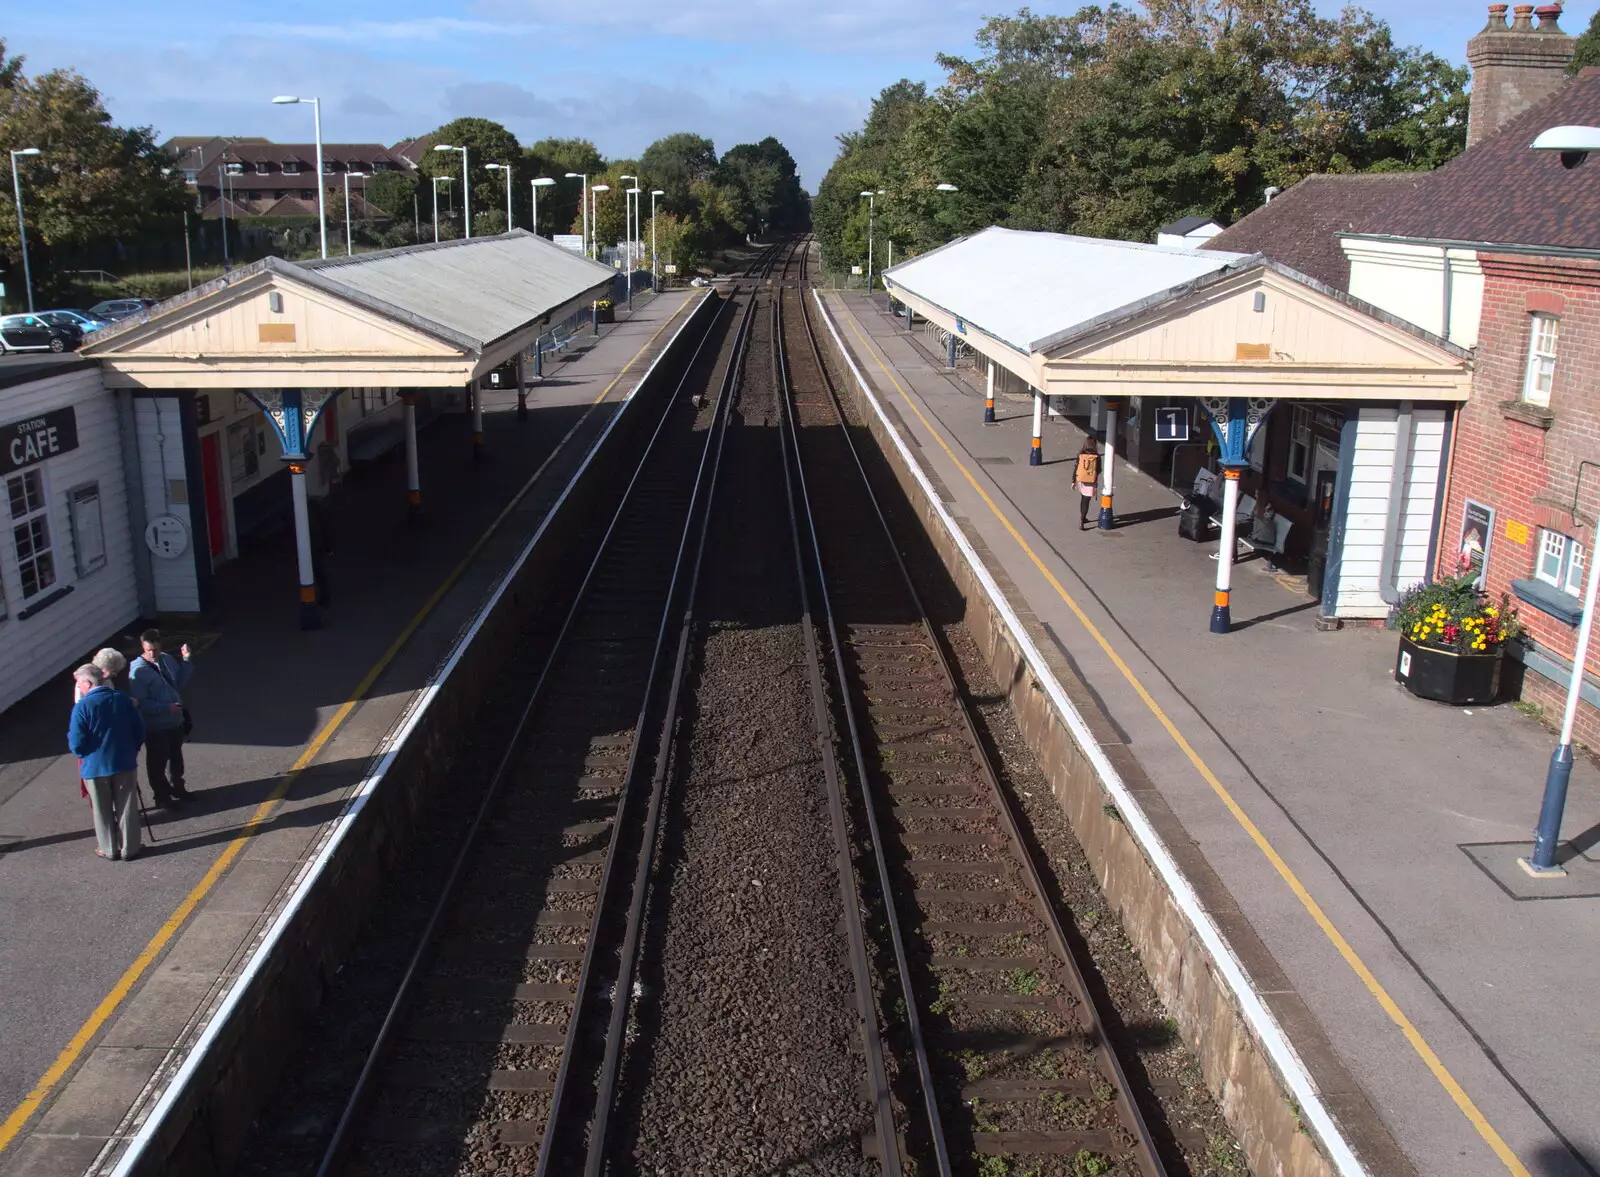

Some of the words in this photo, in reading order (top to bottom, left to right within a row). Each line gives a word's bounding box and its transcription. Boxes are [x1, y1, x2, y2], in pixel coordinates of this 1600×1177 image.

[17, 417, 46, 434] STATION
[1166, 412, 1176, 437] 1
[11, 427, 59, 464] CAFE
